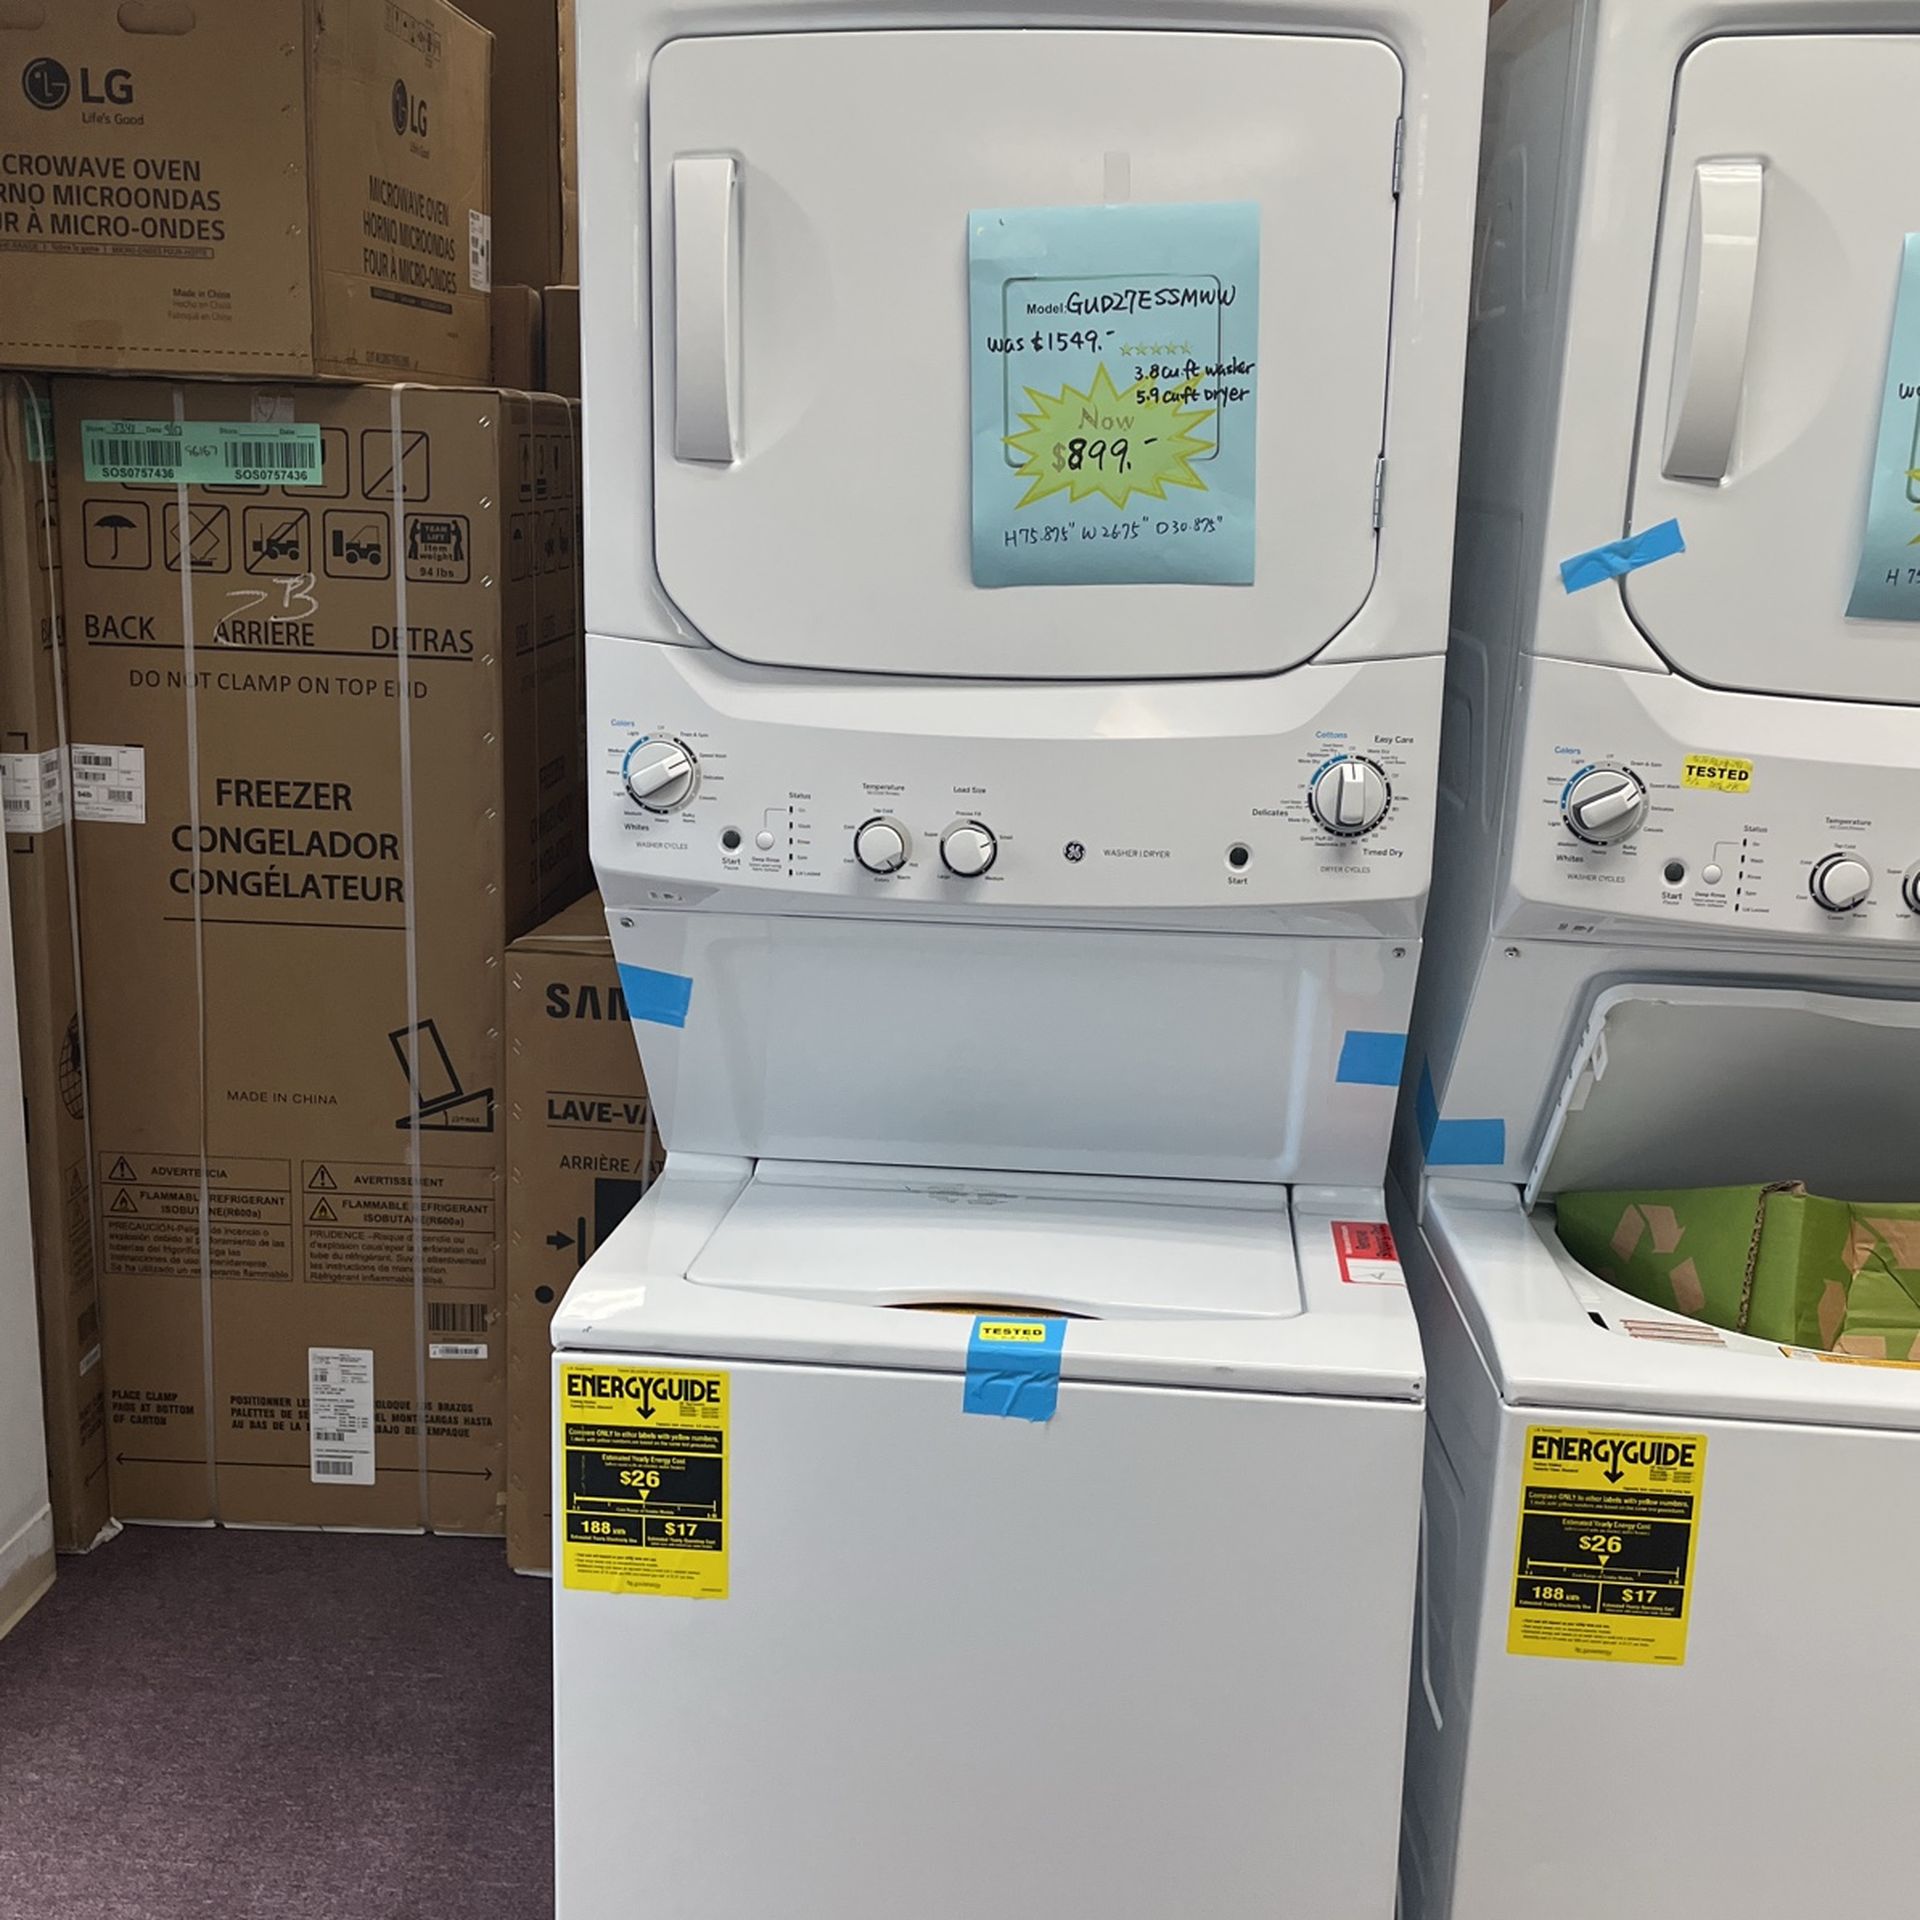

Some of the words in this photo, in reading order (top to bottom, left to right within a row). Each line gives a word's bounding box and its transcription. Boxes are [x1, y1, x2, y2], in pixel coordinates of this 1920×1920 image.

[80, 67, 134, 105] LG
[82, 112, 111, 124] Life's
[114, 113, 144, 125] Good
[410, 95, 427, 137] LG
[3, 154, 125, 179] CROWAVE
[133, 158, 200, 181] OVEN
[53, 184, 221, 211] MICROONDAS
[369, 175, 424, 218] MICROWAVE
[427, 197, 449, 227] OVEN
[0, 211, 19, 232] R
[27, 205, 43, 234] À
[51, 213, 225, 241] MICRO-ONDES
[363, 210, 398, 245] HORNO
[400, 222, 455, 261] MICROONDAS
[363, 247, 389, 277] FOUR
[401, 258, 457, 294] MICRO-ONDES
[1027, 304, 1066, 314] Model:
[1066, 286, 1236, 316] GUD27ESSMWW
[987, 336, 1024, 353] was
[1078, 405, 1134, 430] Now
[102, 467, 175, 479] SOS0757436
[235, 468, 308, 481] SOS0757436
[425, 525, 448, 533] TEAM
[420, 566, 433, 577] 94
[436, 567, 454, 578] lbs
[84, 614, 155, 641] BACK
[130, 669, 160, 688] DO
[167, 671, 211, 690] NOT
[217, 673, 291, 692] CLAMP
[298, 676, 329, 694] ON
[336, 678, 377, 696] TOP
[1315, 731, 1348, 739] Cottons
[1374, 735, 1393, 745] Easy
[1395, 735, 1414, 744] Care
[1554, 746, 1581, 755] Colors
[1686, 764, 1749, 781] TESTED
[862, 782, 905, 792] Temperature
[953, 785, 970, 794] Load
[973, 786, 987, 794] Size
[215, 778, 352, 812] FREEZER
[788, 791, 812, 800] Status
[1252, 808, 1289, 817] Delicates
[624, 822, 650, 832] Whites
[1825, 816, 1872, 826] Temperature
[1743, 825, 1768, 834] Status
[171, 825, 399, 860] CONGELADOR
[636, 841, 663, 850] WASHER
[664, 842, 688, 851] CYCLES
[1364, 848, 1387, 857] Timed
[1389, 848, 1403, 858] Dry
[1556, 854, 1584, 864] Whites
[721, 857, 741, 866] Start
[1320, 865, 1343, 874] DRYER
[169, 864, 404, 903] CONGÉLATEUR
[1227, 876, 1248, 885] Start
[1567, 873, 1596, 882] WASHER
[1598, 874, 1626, 884] CYCLES
[1661, 891, 1683, 901] Start
[227, 1090, 268, 1102] MADE
[272, 1093, 287, 1103] IN
[292, 1093, 338, 1105] CHINA
[559, 1153, 630, 1173] ARRIÈRE
[151, 1166, 228, 1179] ADVERTECIA
[353, 1175, 444, 1188] AVERTISSEENT
[139, 1190, 201, 1202] FLAMMABL
[209, 1193, 285, 1206] REFRIGERANT
[161, 1204, 262, 1219] ISOBUTNE(R600a)
[342, 1199, 409, 1213] FLAMMABLE
[412, 1203, 489, 1215] EFRIGERANT
[364, 1213, 465, 1228] ISOBUTAE(R600a)
[983, 1327, 1043, 1336] TESTED
[112, 1390, 141, 1401] PLACE
[146, 1392, 178, 1402] CLAMP
[567, 1373, 721, 1406] ENERGYGUIDE
[157, 1405, 194, 1415] BOTTOM
[231, 1407, 275, 1419] PALETTES
[281, 1410, 292, 1419] DE
[113, 1415, 124, 1424] OF
[130, 1416, 167, 1426] CARTON
[232, 1420, 244, 1429] AU
[249, 1421, 267, 1430] BAS
[273, 1422, 285, 1431] DE
[290, 1422, 302, 1431] LA
[391, 1413, 459, 1425] MONTCARGAS
[464, 1416, 493, 1426] HASTA
[427, 1428, 470, 1438] EMPAQUE
[596, 1428, 613, 1438] ONLY
[638, 1430, 657, 1441] labels
[671, 1432, 691, 1443] yellow
[1531, 1435, 1697, 1470] ENERGYGUIDE
[601, 1454, 631, 1464] Estimated
[632, 1455, 649, 1466] Yearly
[650, 1457, 671, 1468] Energy
[672, 1457, 686, 1467] Cost
[620, 1470, 660, 1488] $26
[1557, 1493, 1576, 1501] ONLY
[1602, 1496, 1622, 1505] labels
[1638, 1498, 1658, 1508] yellow
[581, 1520, 611, 1535] 188
[664, 1522, 698, 1536] $17
[1562, 1518, 1593, 1527] Estimated
[1593, 1519, 1612, 1530] Yearly
[1613, 1521, 1636, 1531] Energy
[1636, 1522, 1651, 1531] Cost
[1579, 1535, 1622, 1553] $26
[1532, 1586, 1565, 1600] 188
[1621, 1588, 1658, 1603] $17
